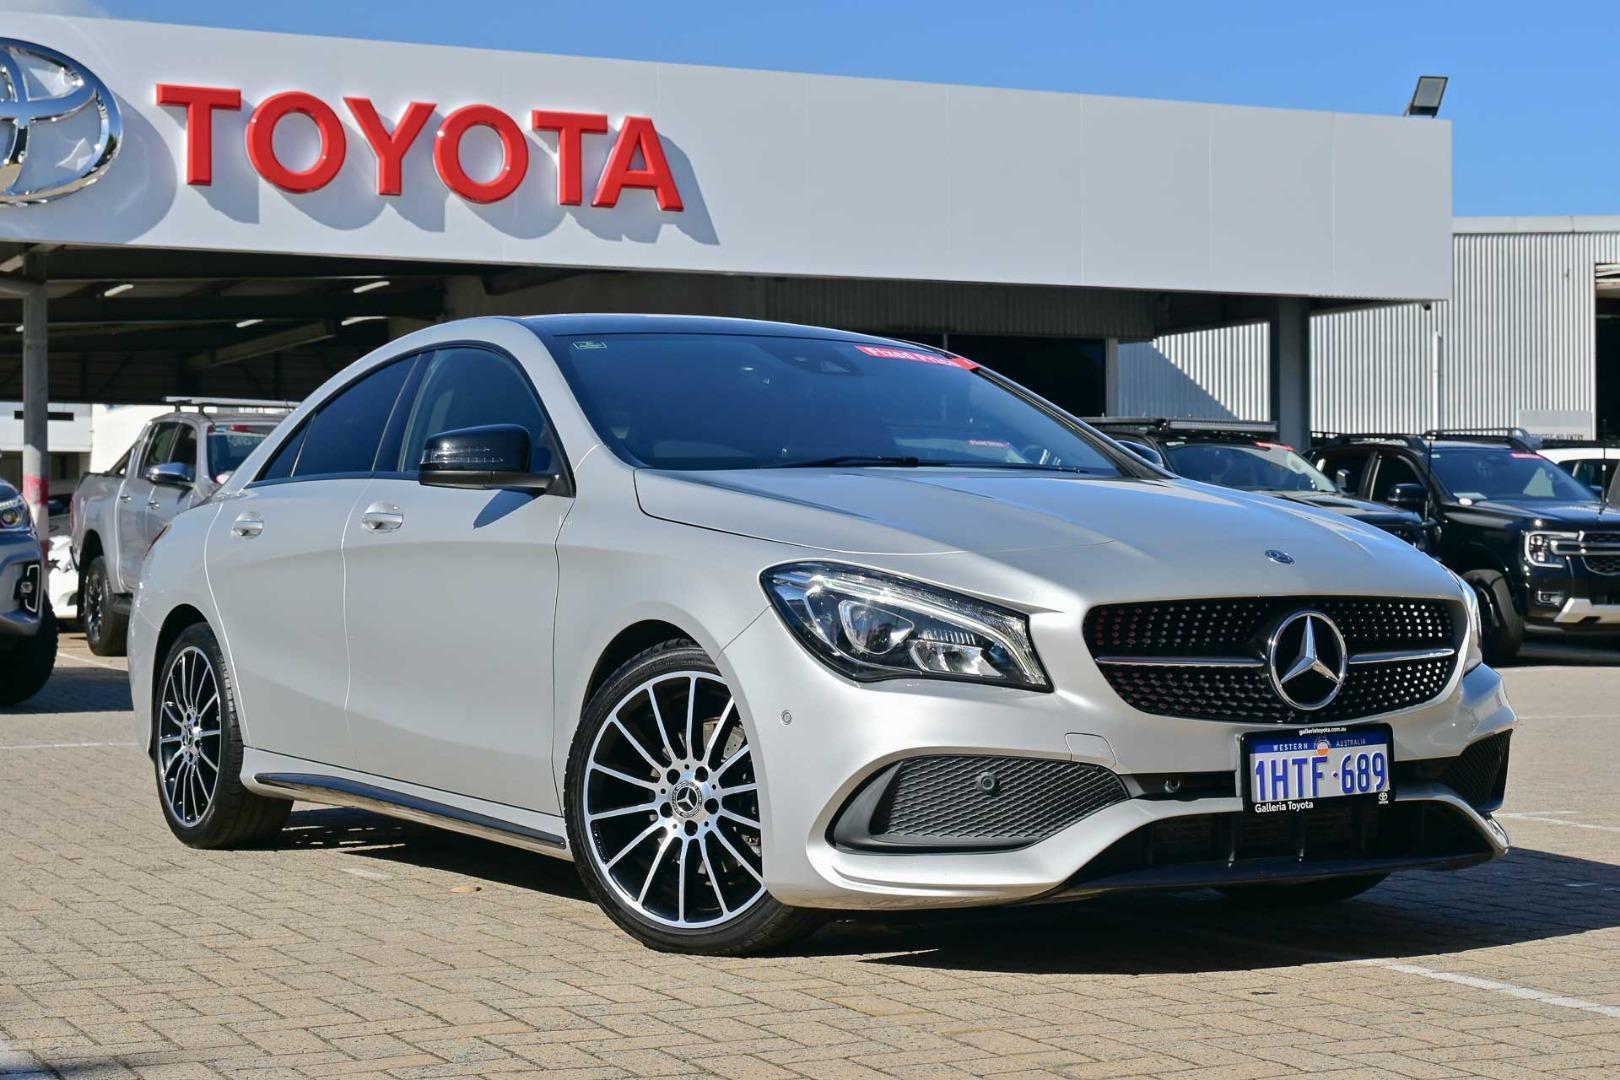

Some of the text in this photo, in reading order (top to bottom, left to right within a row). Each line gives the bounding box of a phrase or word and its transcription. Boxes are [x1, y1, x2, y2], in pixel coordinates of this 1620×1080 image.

[156, 84, 684, 212] TOYOTA
[1273, 738, 1366, 752] WESTERN AUSTRALIA
[1255, 801, 1314, 813] Galleria Toyota
